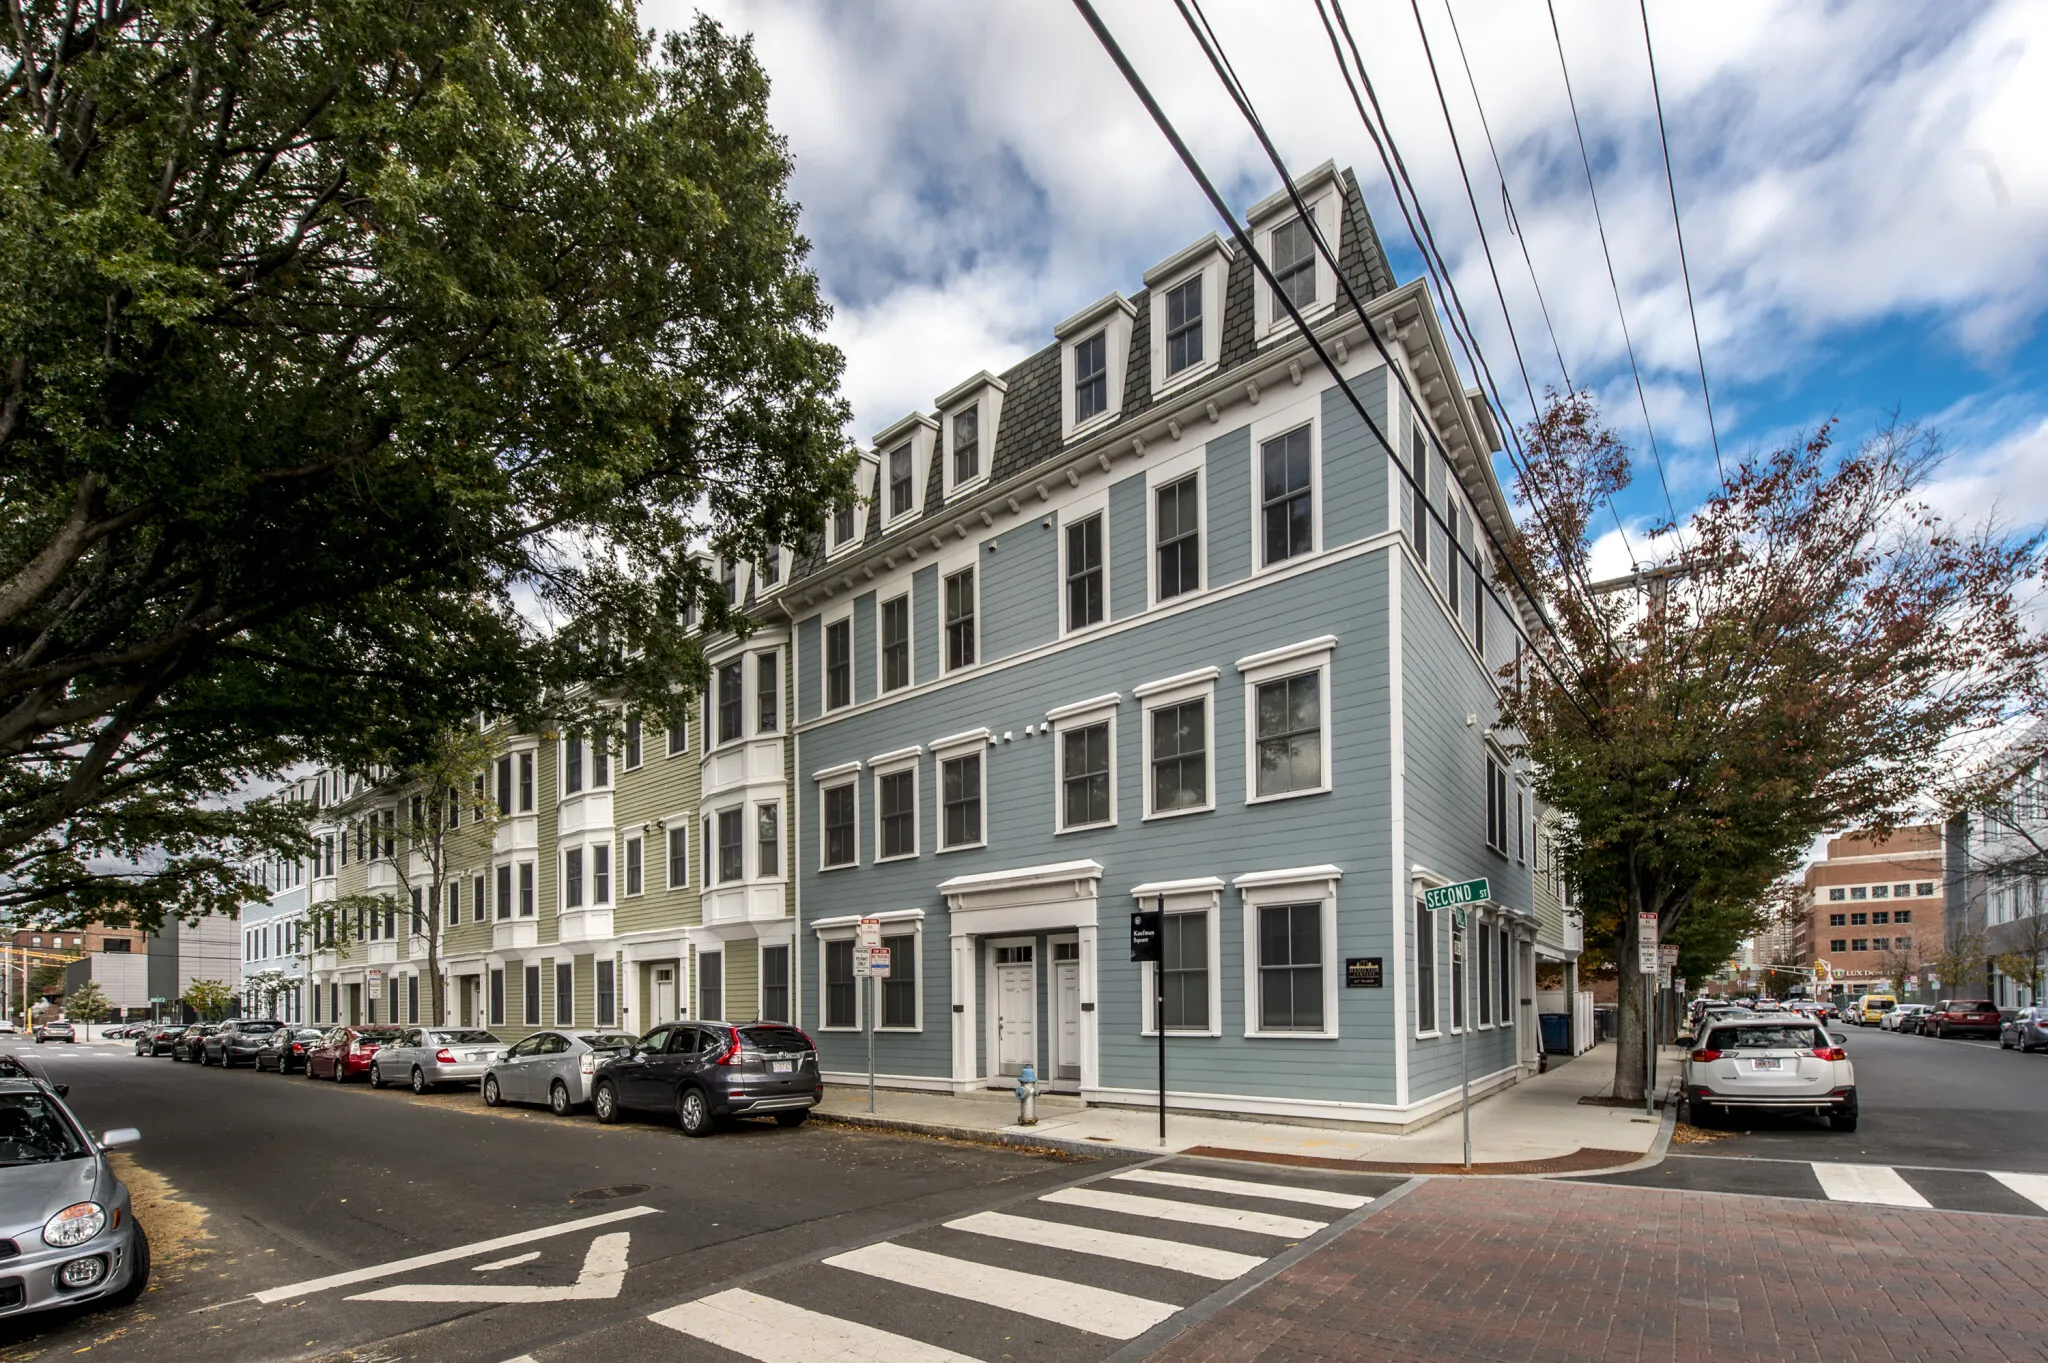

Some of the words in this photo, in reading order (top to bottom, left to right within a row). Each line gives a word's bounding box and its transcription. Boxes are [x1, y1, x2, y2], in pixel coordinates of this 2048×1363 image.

[1427, 884, 1472, 908] SECOND
[1479, 888, 1488, 898] ST
[1133, 929, 1155, 937] Kaufman
